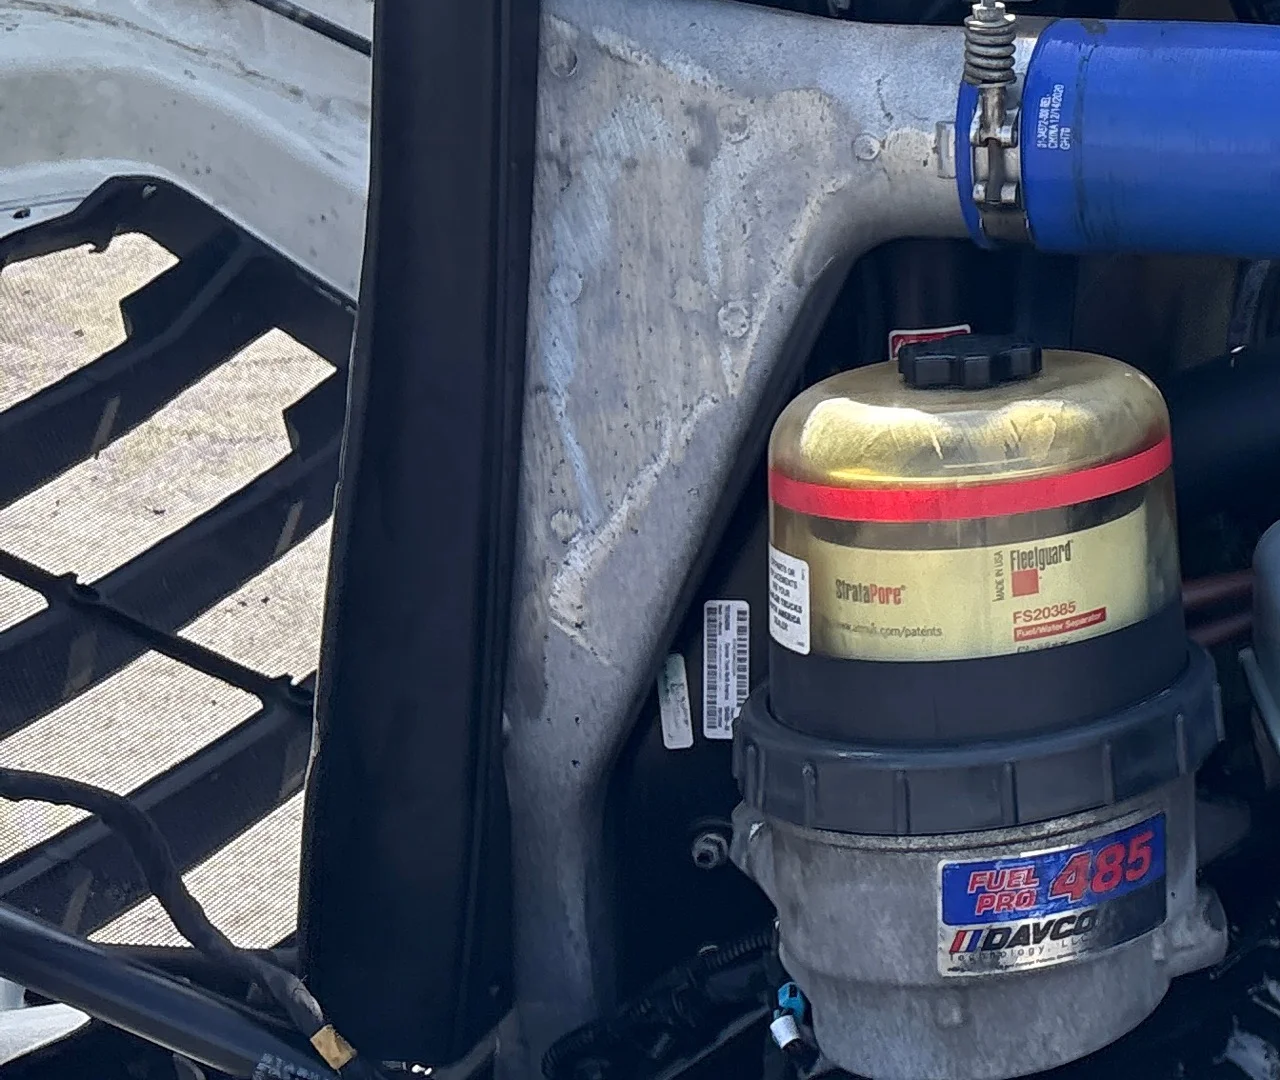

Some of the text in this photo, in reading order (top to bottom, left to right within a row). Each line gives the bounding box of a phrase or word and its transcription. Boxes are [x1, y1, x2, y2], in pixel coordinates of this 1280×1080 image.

[1048, 124, 1060, 148] CHINA
[1010, 540, 1073, 571] Fleetguard
[992, 550, 1005, 602] MADE IN USA
[1013, 600, 1076, 624] FS20385
[1016, 613, 1103, 638] Fuel/Water Separator
[968, 865, 1039, 893] FUEL
[1049, 831, 1153, 904] 485
[975, 889, 1038, 916] PRO
[982, 910, 1098, 951] DAVCO
